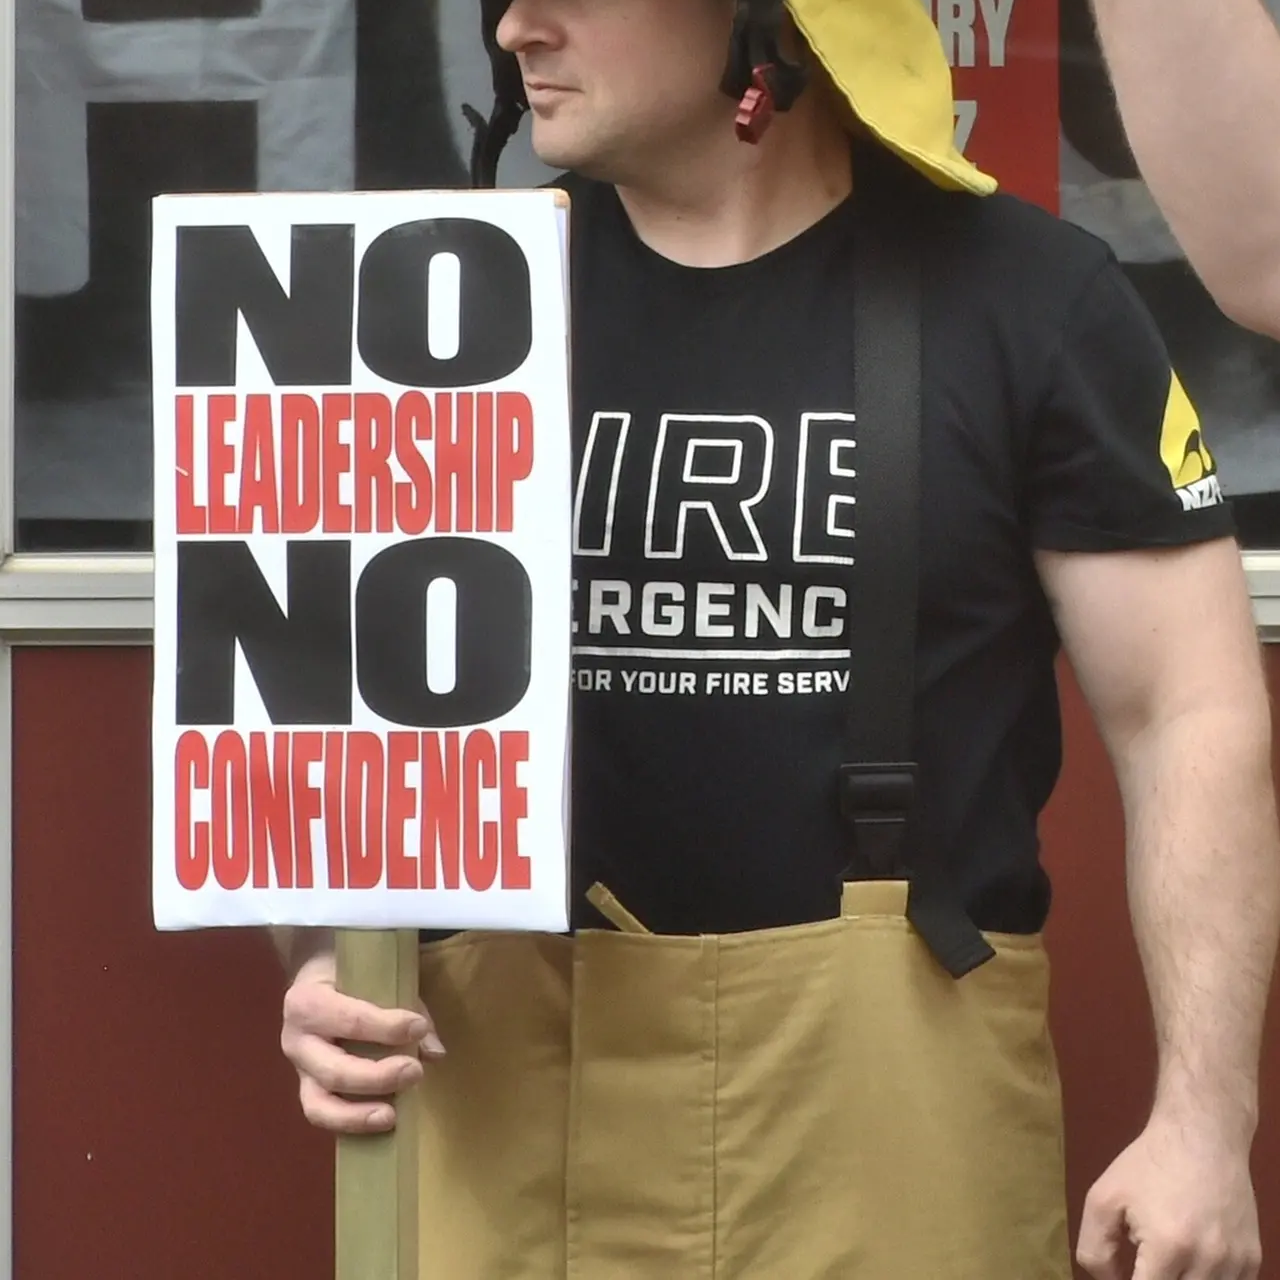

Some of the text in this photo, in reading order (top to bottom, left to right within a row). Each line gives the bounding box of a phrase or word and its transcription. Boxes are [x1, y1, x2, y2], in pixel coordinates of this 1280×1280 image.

[174, 217, 533, 388] NO
[175, 390, 534, 535] LEADERSHIP
[176, 536, 533, 728] NO
[572, 578, 848, 638] RGENC
[620, 670, 697, 695] YOUR
[705, 671, 769, 696] FIRE
[776, 669, 851, 695] SERV
[174, 729, 531, 892] CONFIDENCE
